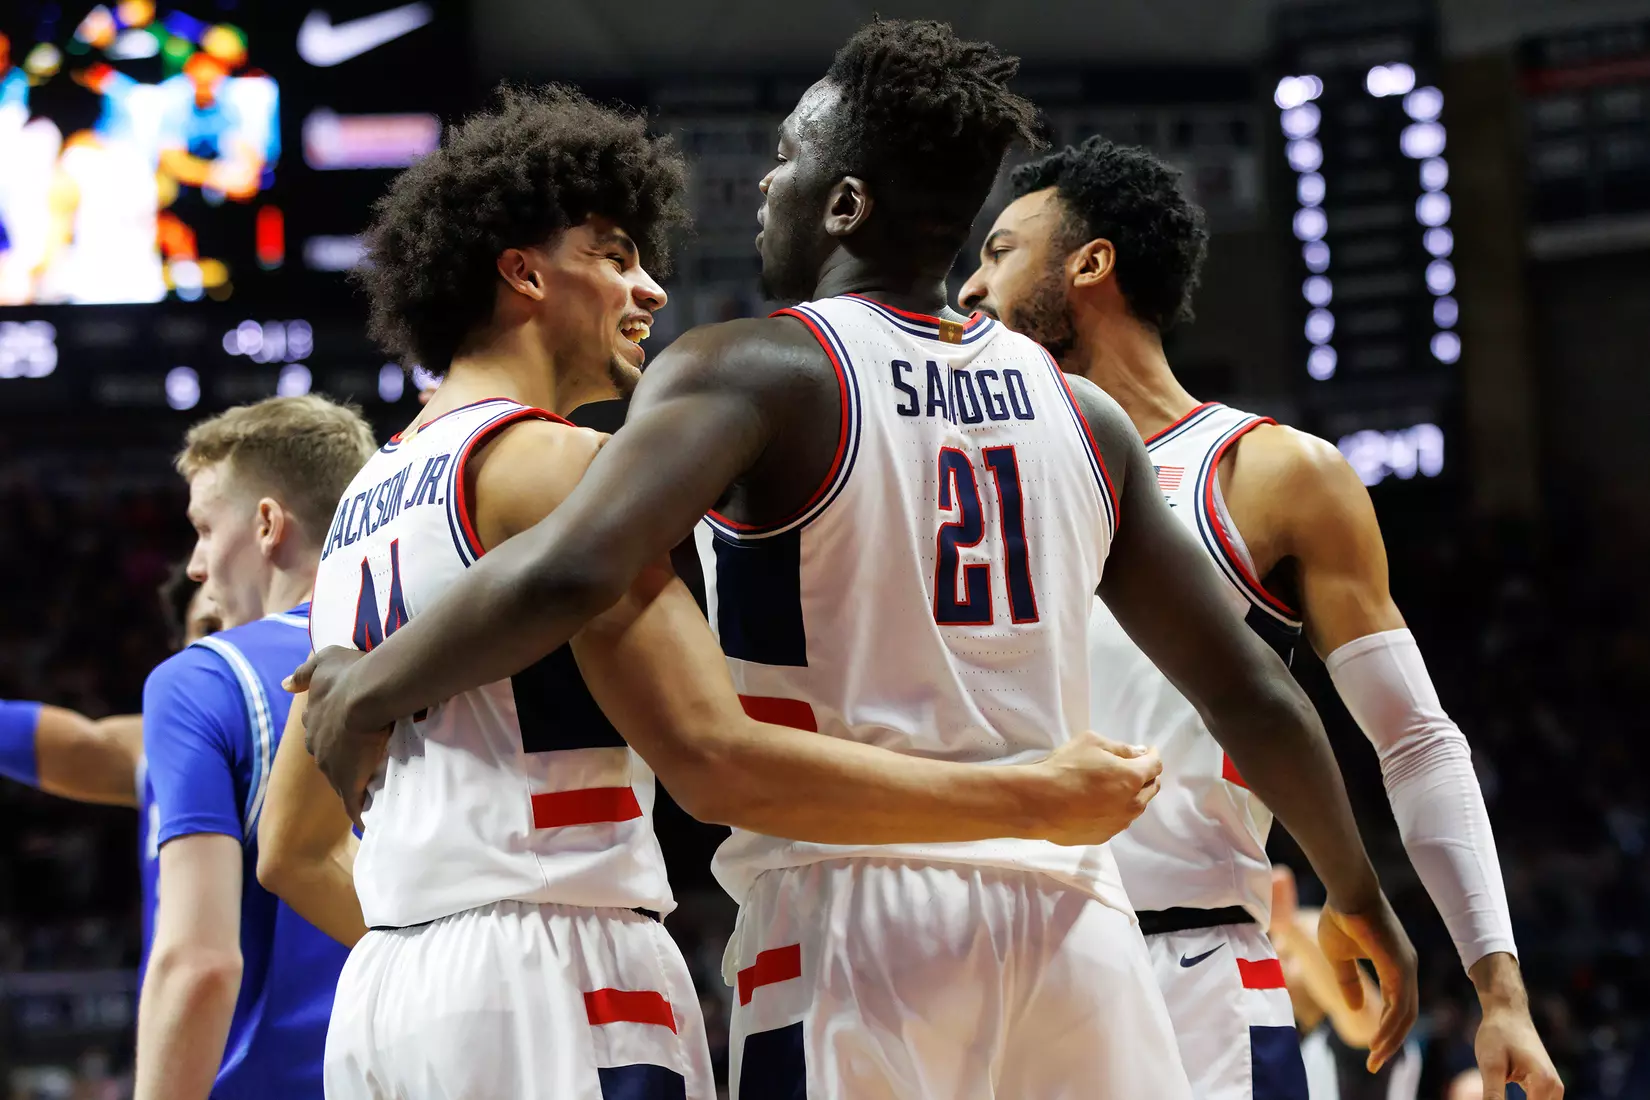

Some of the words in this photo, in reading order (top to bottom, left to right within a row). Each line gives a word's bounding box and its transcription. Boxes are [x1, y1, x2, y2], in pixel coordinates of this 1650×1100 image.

[321, 462, 413, 561] JACKSON
[404, 454, 451, 510] JR.
[933, 445, 1040, 625] 21
